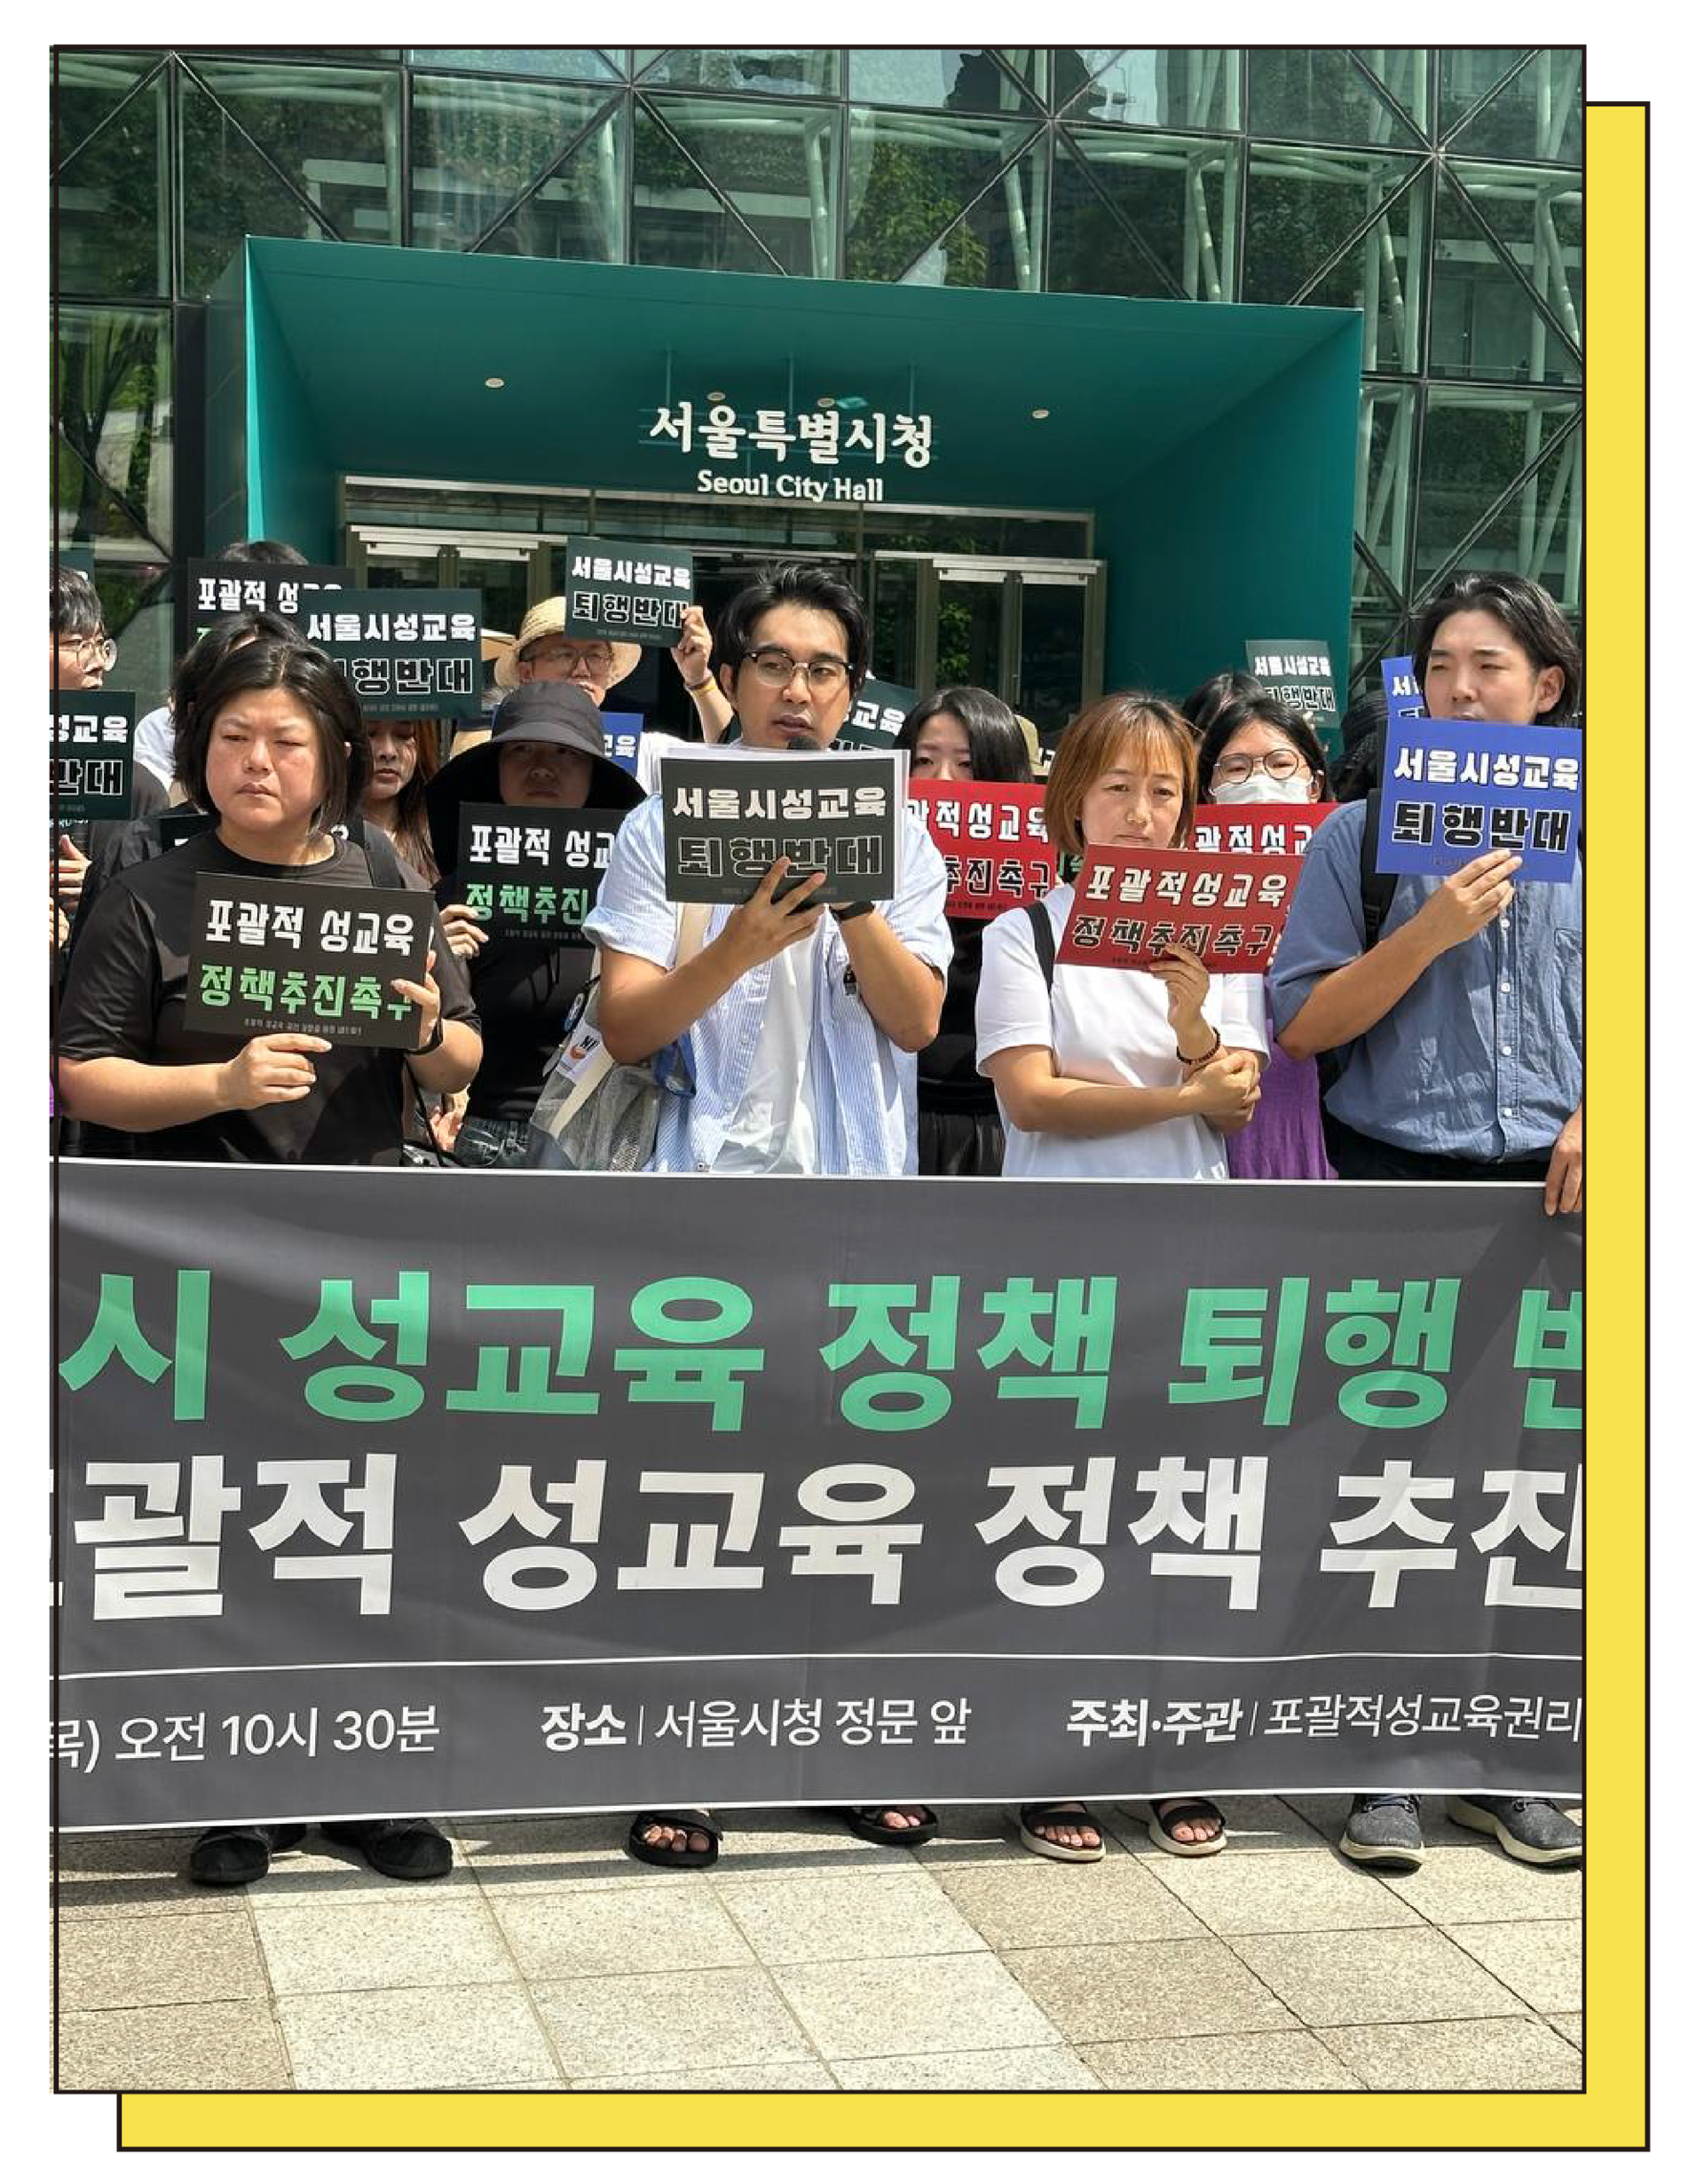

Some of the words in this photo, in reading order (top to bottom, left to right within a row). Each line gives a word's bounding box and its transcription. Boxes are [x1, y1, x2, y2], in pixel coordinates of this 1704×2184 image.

[650, 401, 933, 468] 서울특별시청
[698, 470, 769, 496] Seoul
[776, 474, 828, 502] City
[833, 477, 883, 501] Hall
[197, 578, 266, 612] 포괄적
[572, 556, 691, 590] 서울시성교육
[307, 612, 477, 643] 서울시성교육
[572, 590, 690, 628] 퇴행반대
[334, 658, 473, 696] 행반대
[1393, 746, 1581, 792] 서울시성교육
[672, 787, 887, 820] 서울시성교육
[469, 824, 550, 866] 포괄적
[1392, 800, 1572, 853] 퇴행반대
[678, 835, 883, 878] 퇴행반대
[1085, 864, 1288, 908] 포괄적성교육
[206, 899, 304, 949] 포괄적
[320, 909, 414, 956] 성교육
[1072, 914, 1274, 958] 정책추진촉구
[279, 1269, 765, 1431] 성교육
[818, 1275, 1118, 1431] 정책
[1168, 1276, 1462, 1429] 퇴행
[48, 1453, 398, 1620] 괄적
[459, 1459, 925, 1611] 성교육
[974, 1455, 1269, 1611] 정책
[114, 1712, 206, 1762] 오전
[221, 1707, 319, 1757] 10시
[333, 1704, 441, 1753] 30분
[540, 1702, 627, 1752] 장소
[655, 1698, 824, 1748] 서울시청
[835, 1697, 919, 1747] 정문
[929, 1697, 973, 1746] 앞
[1263, 1693, 1583, 1744] 포괄적성교육권리
